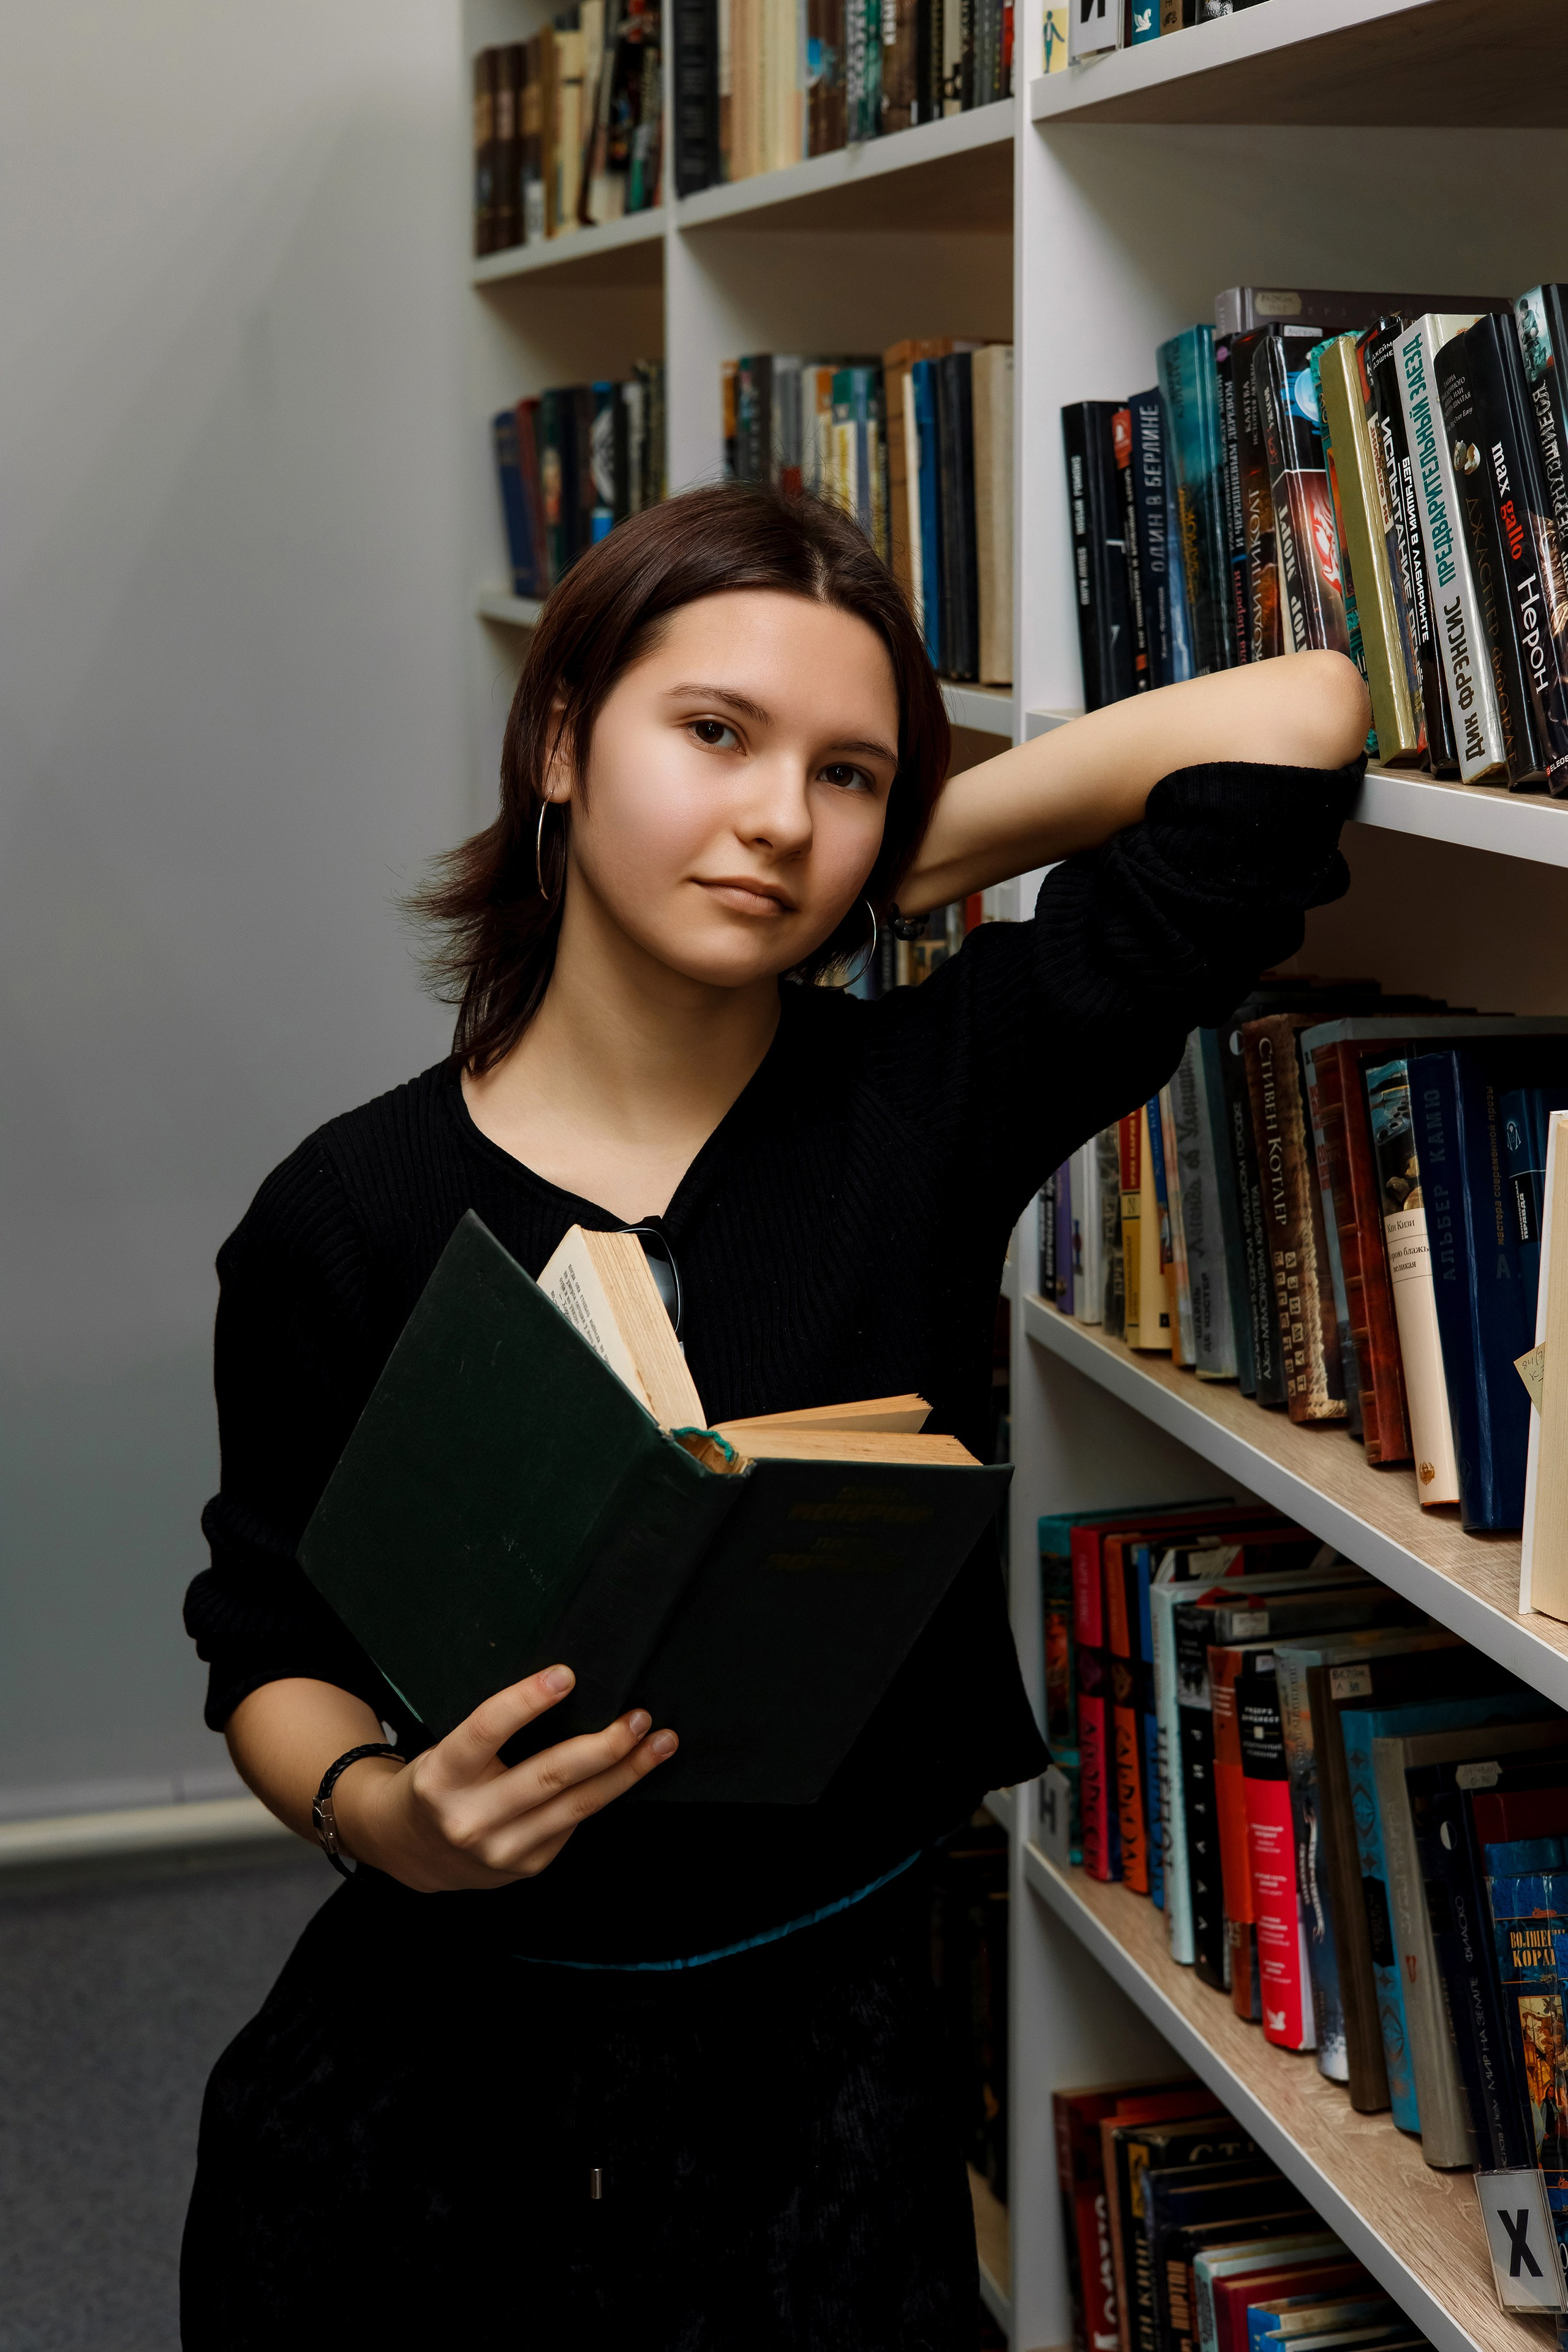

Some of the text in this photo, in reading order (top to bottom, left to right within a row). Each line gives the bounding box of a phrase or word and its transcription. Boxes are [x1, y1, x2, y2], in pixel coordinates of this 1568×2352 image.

[1372, 341, 1394, 362] ДЖЕЙМ
[1373, 350, 1394, 370] ДЭШНЕ
[1224, 380, 1239, 439] ДЕРЕВОМ
[1462, 407, 1473, 421] Easy
[1139, 404, 1166, 573] ОДИН В БЕРЛИНЕ
[1381, 416, 1413, 599] ИСПЫТАНИЕ
[1403, 333, 1457, 587] ПРЕДВАРИТЕЛЬНЫЙ ЗАЕЗД
[1491, 440, 1525, 560] max gallo
[1248, 489, 1264, 662] ЖОДИ ПИКОЛТ
[1278, 506, 1297, 583] МОРТ
[1403, 456, 1430, 644] БЕГУЩИЙ В ЛАБИРИНТЕ
[1466, 496, 1500, 638] ДЖАСПЕР
[1444, 595, 1486, 763] ДИК ФРЭНСИС
[1517, 573, 1550, 696] Нерон
[1423, 1088, 1457, 1281] АЛЬБЕР КАМЮ
[1485, 1085, 1505, 1246] мастера современной прозы
[1515, 1180, 1525, 1241] КОМСОМОЛЬСКАЯ
[1387, 1219, 1415, 1233] Кен Кизи
[1403, 1246, 1429, 1256] блажь
[1519, 1192, 1529, 1240] ПРАВДА
[1200, 1271, 1212, 1330] КОСТЕР
[1393, 1261, 1416, 1273] великая
[1454, 1894, 1474, 1963] ФИАСКО
[1468, 1976, 1498, 2090] МИР НА ЗЕМЛЕ
